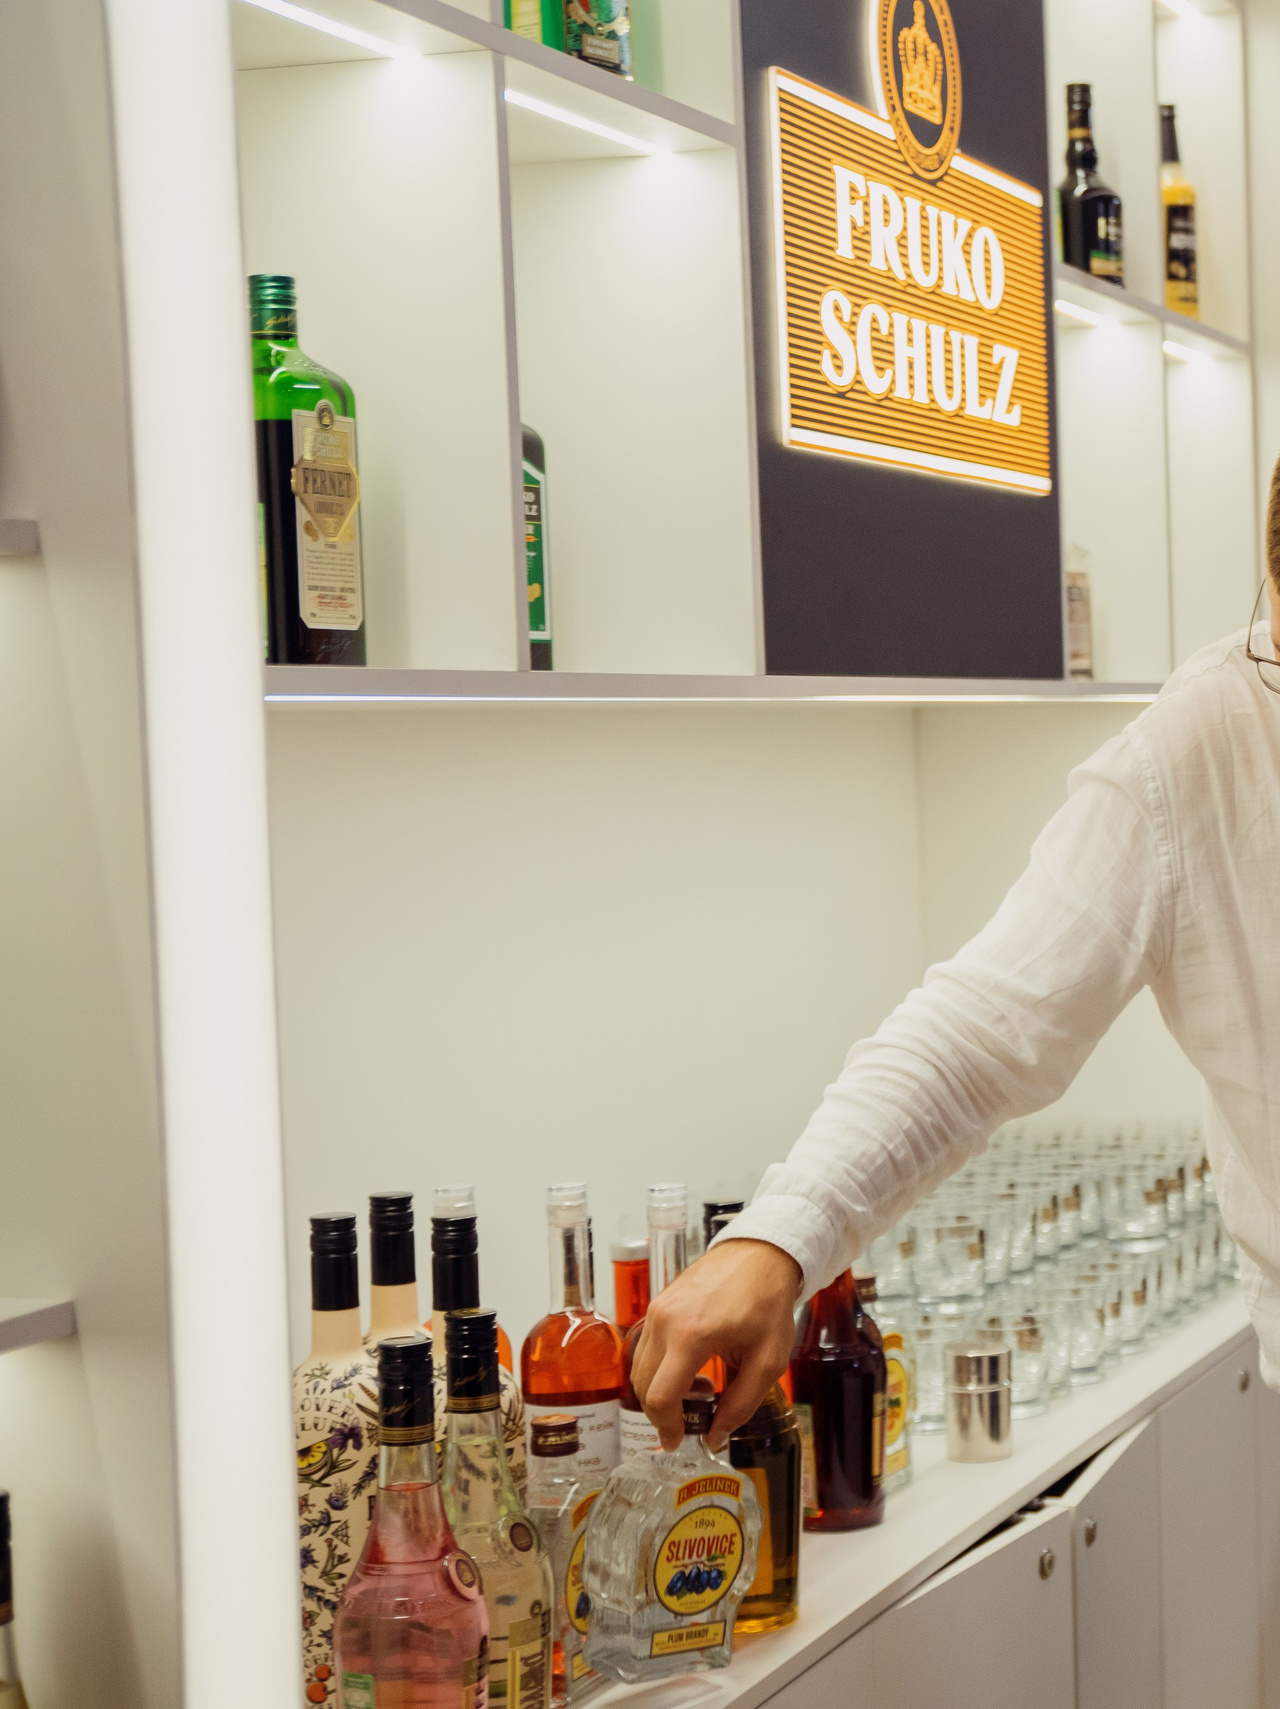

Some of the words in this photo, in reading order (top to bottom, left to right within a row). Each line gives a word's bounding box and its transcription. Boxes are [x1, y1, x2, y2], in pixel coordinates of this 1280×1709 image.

[833, 164, 1006, 310] FRUKO
[820, 289, 1022, 427] SCHULZ
[301, 466, 352, 499] FERNET
[694, 1517, 716, 1530] 1894
[665, 1532, 737, 1564] SLIVOVICE
[667, 1629, 685, 1645] PLUM
[685, 1627, 709, 1642] BRANDY
